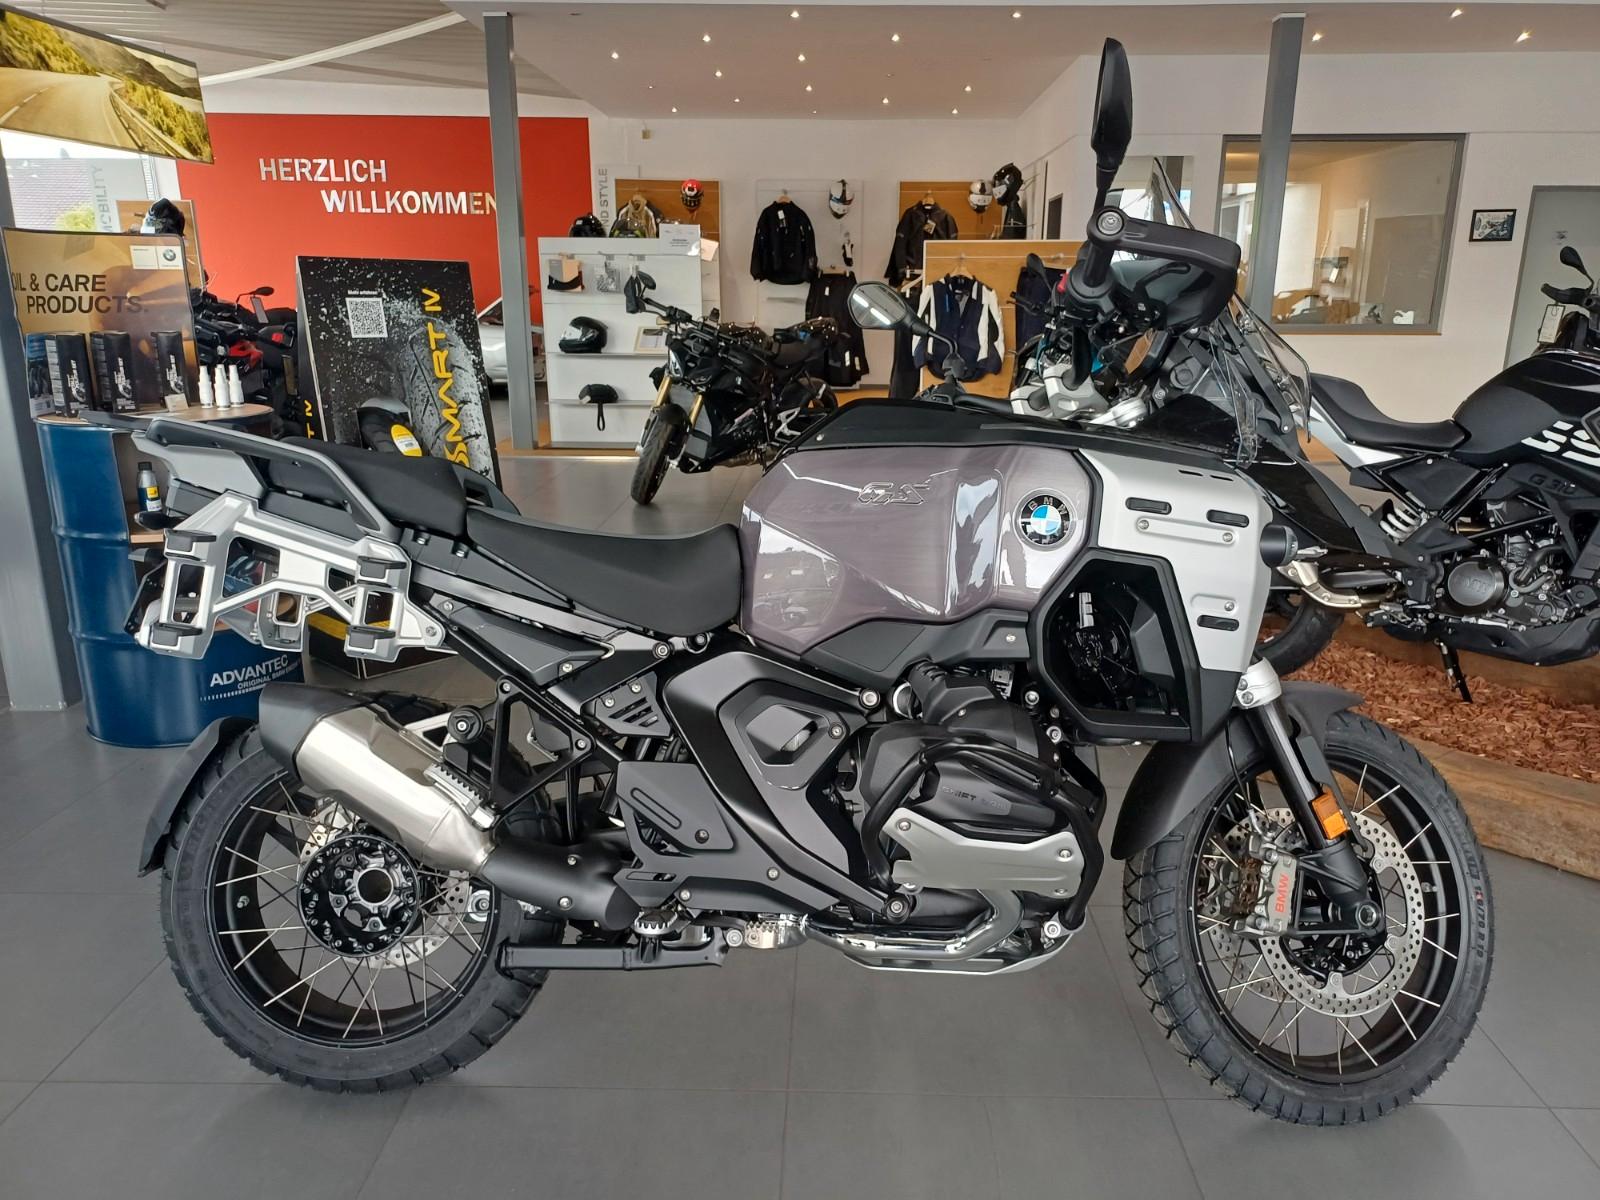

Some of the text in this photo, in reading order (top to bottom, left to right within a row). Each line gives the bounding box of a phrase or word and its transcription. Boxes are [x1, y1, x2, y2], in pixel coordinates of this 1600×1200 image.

[258, 158, 388, 183] HERZLICH
[598, 168, 608, 207] STYLE
[30, 273, 40, 292] &
[45, 273, 107, 292] CARE
[27, 295, 149, 314] PRODUCTS.
[421, 287, 441, 312] IV
[1028, 496, 1068, 515] BMW
[210, 655, 287, 687] ADVANTEC
[237, 676, 270, 689] ORIGINAL
[1275, 873, 1289, 913] BMW
